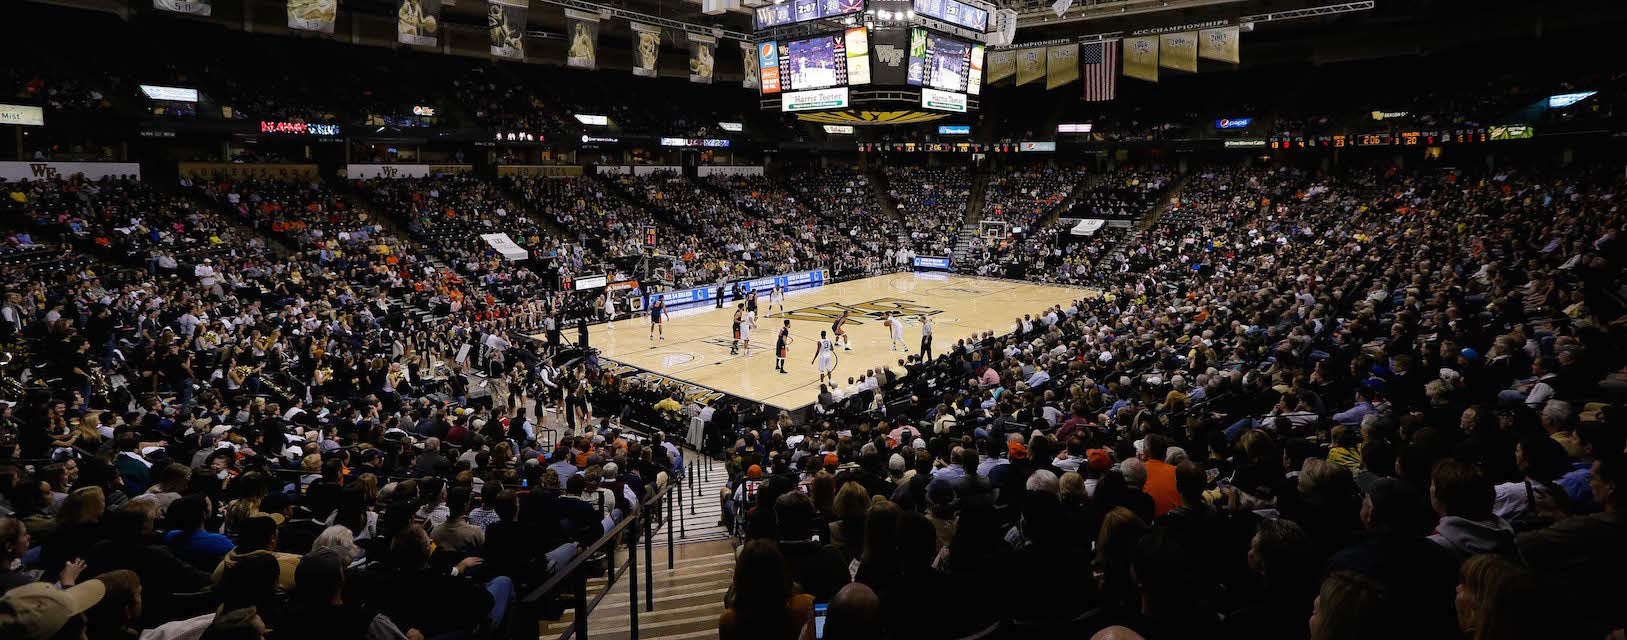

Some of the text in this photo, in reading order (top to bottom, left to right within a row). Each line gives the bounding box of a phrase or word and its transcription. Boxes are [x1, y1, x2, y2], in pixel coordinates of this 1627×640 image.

[1151, 20, 1229, 34] CHAMPIONSHIPS
[1009, 38, 1070, 49] CHAMPIONSHIPS
[875, 45, 904, 66] WF
[794, 92, 842, 103] Harris Teeter
[1229, 119, 1247, 127] pepsi
[1363, 135, 1380, 144] 2:06
